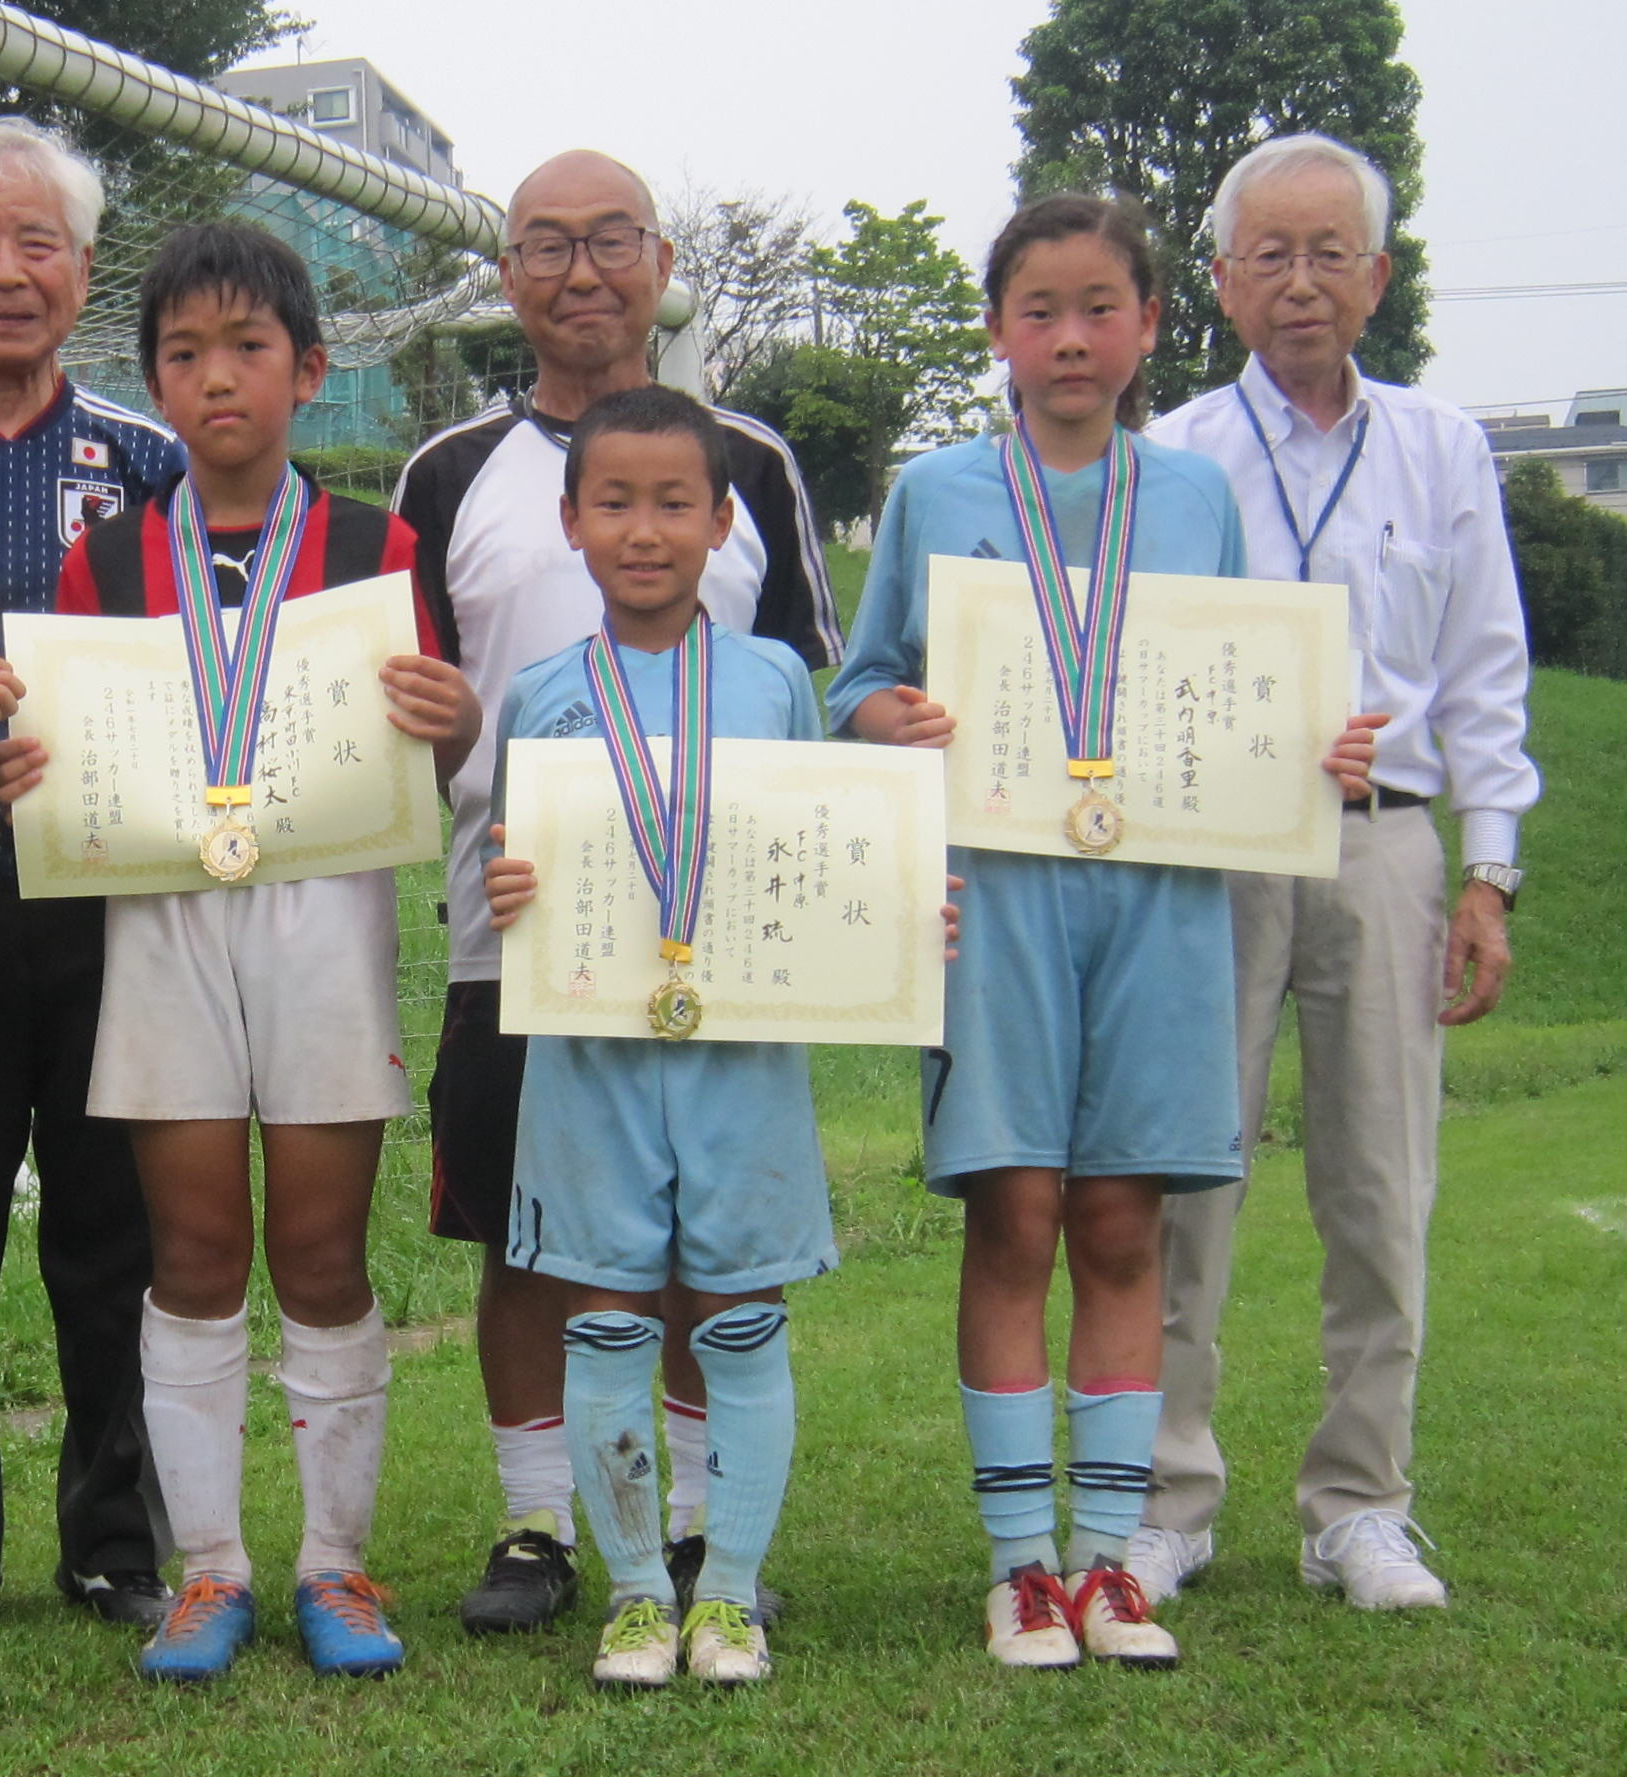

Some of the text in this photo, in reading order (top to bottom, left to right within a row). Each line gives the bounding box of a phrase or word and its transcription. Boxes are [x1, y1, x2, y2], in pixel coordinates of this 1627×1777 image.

[75, 483, 109, 494] JAPAN
[554, 714, 598, 737] adida
[813, 804, 831, 899] 優秀選手賞
[841, 836, 872, 926] 賞状
[929, 1048, 953, 1126] 7
